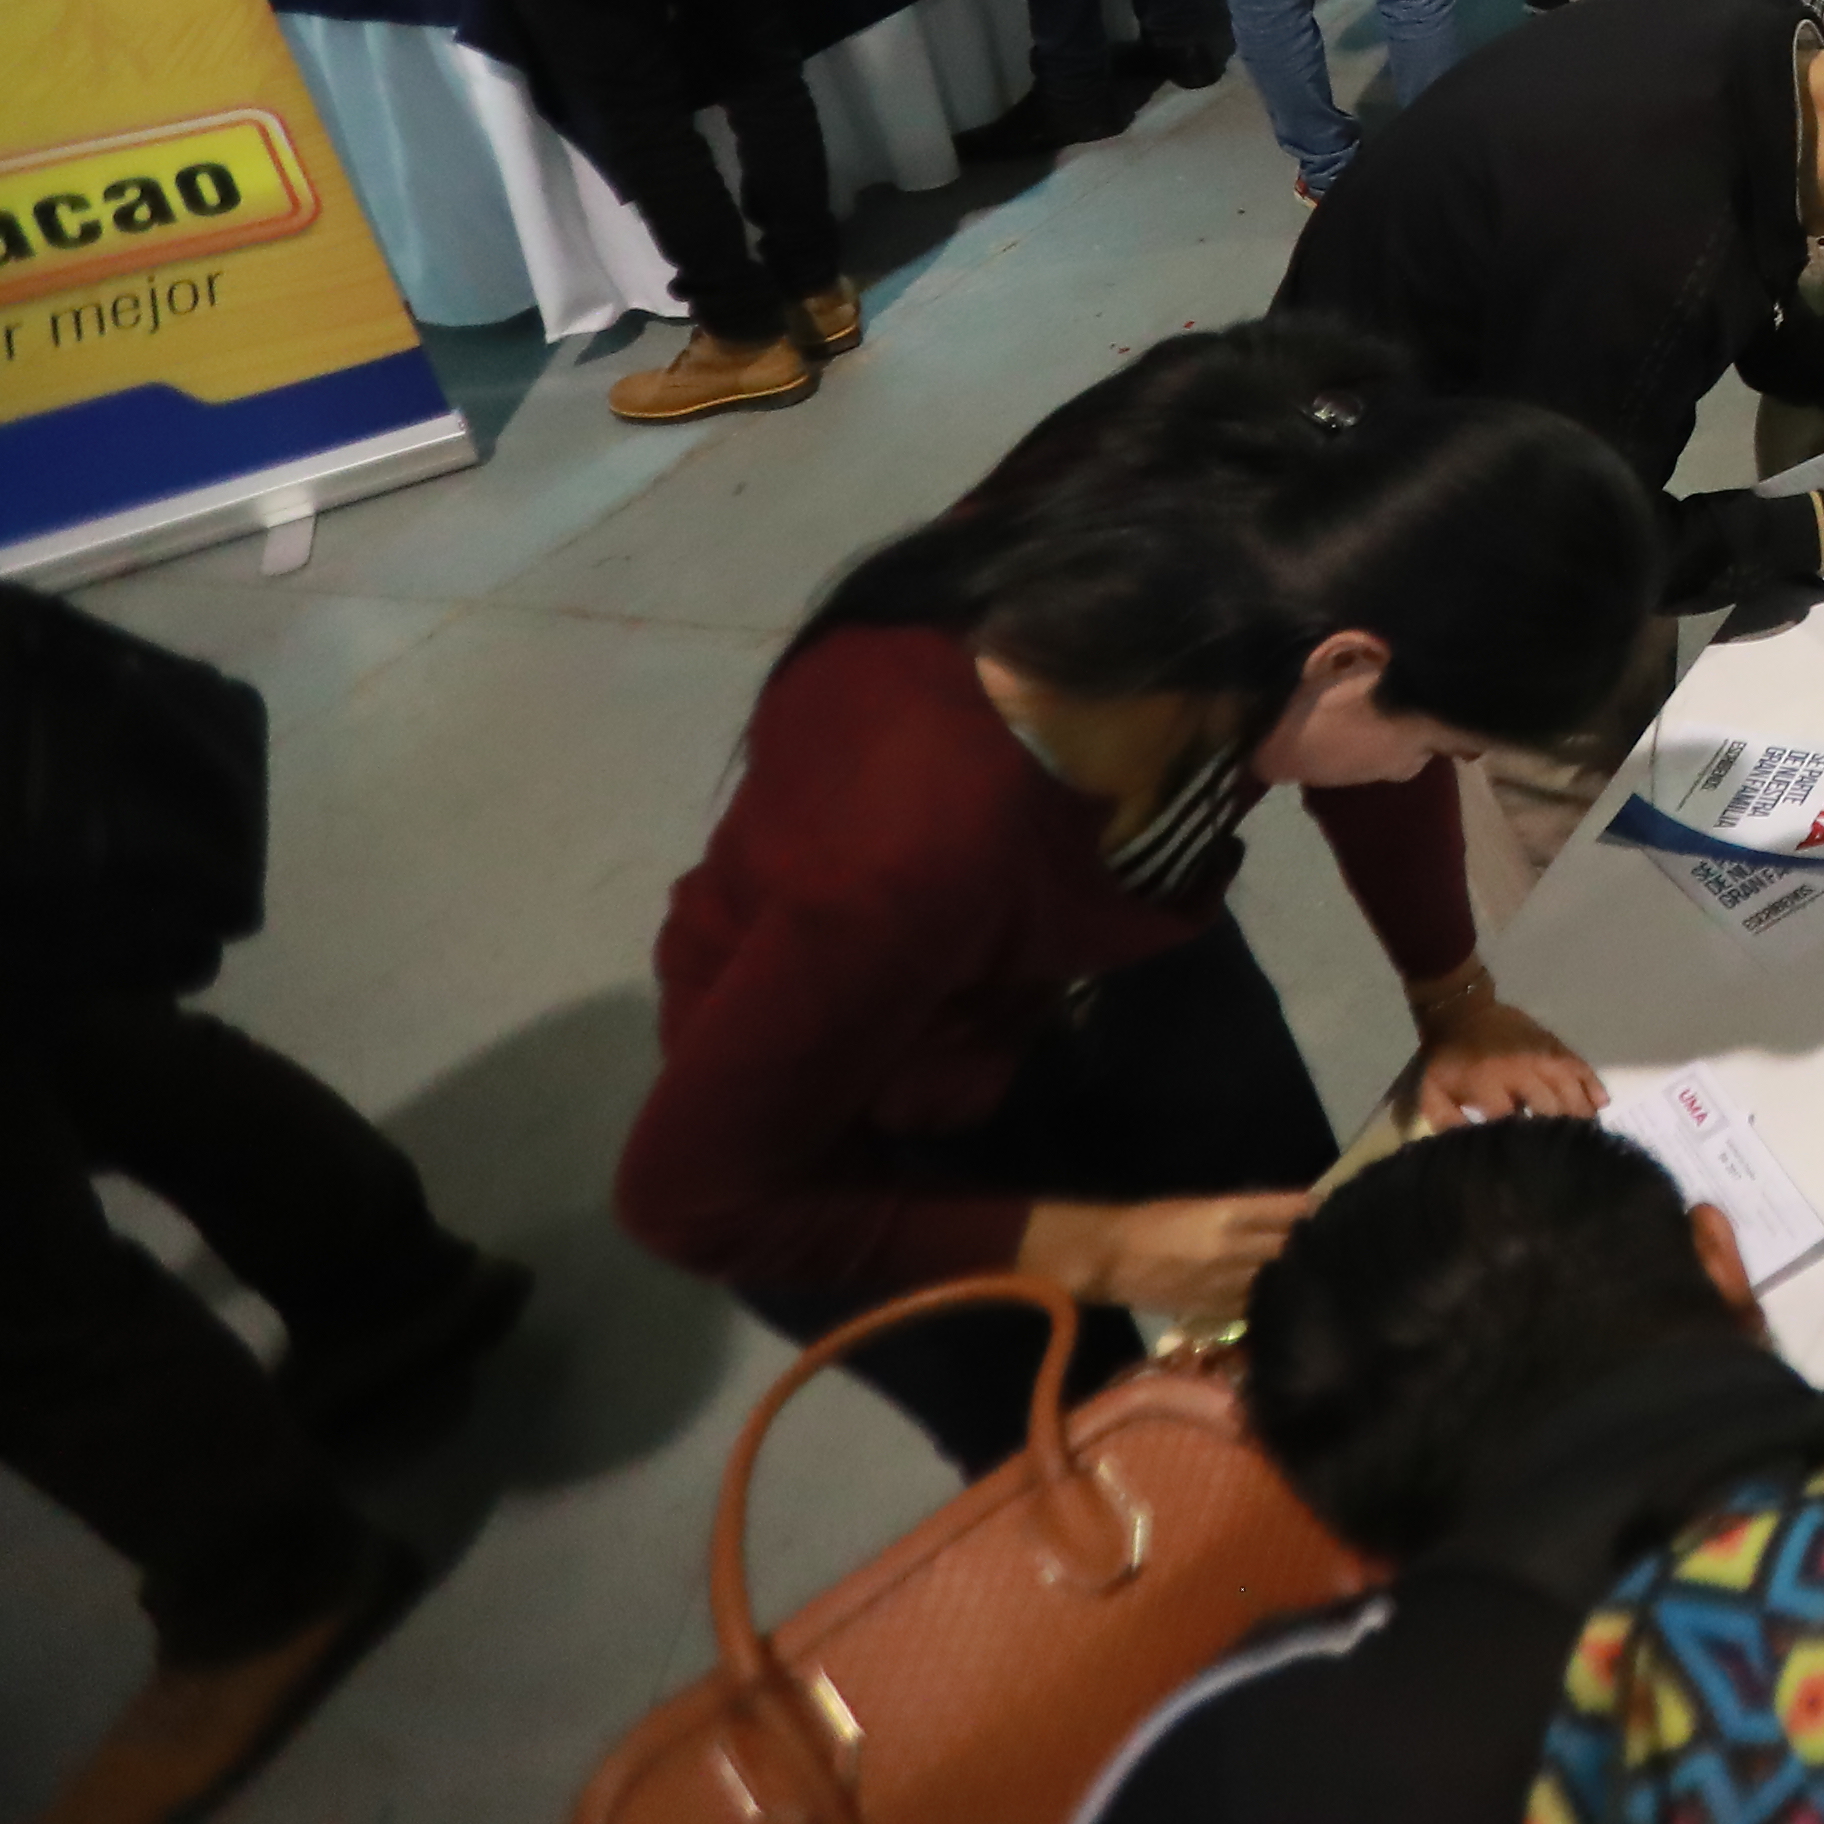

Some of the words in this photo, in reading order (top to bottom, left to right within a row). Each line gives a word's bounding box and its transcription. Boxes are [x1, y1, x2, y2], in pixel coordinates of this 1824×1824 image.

[49, 270, 224, 350] mejor
[1712, 778, 1765, 829] FAMILIA
[1747, 766, 1799, 818] NUESTRA
[1781, 768, 1824, 806] PARTE
[1678, 1087, 1708, 1127] UMA
